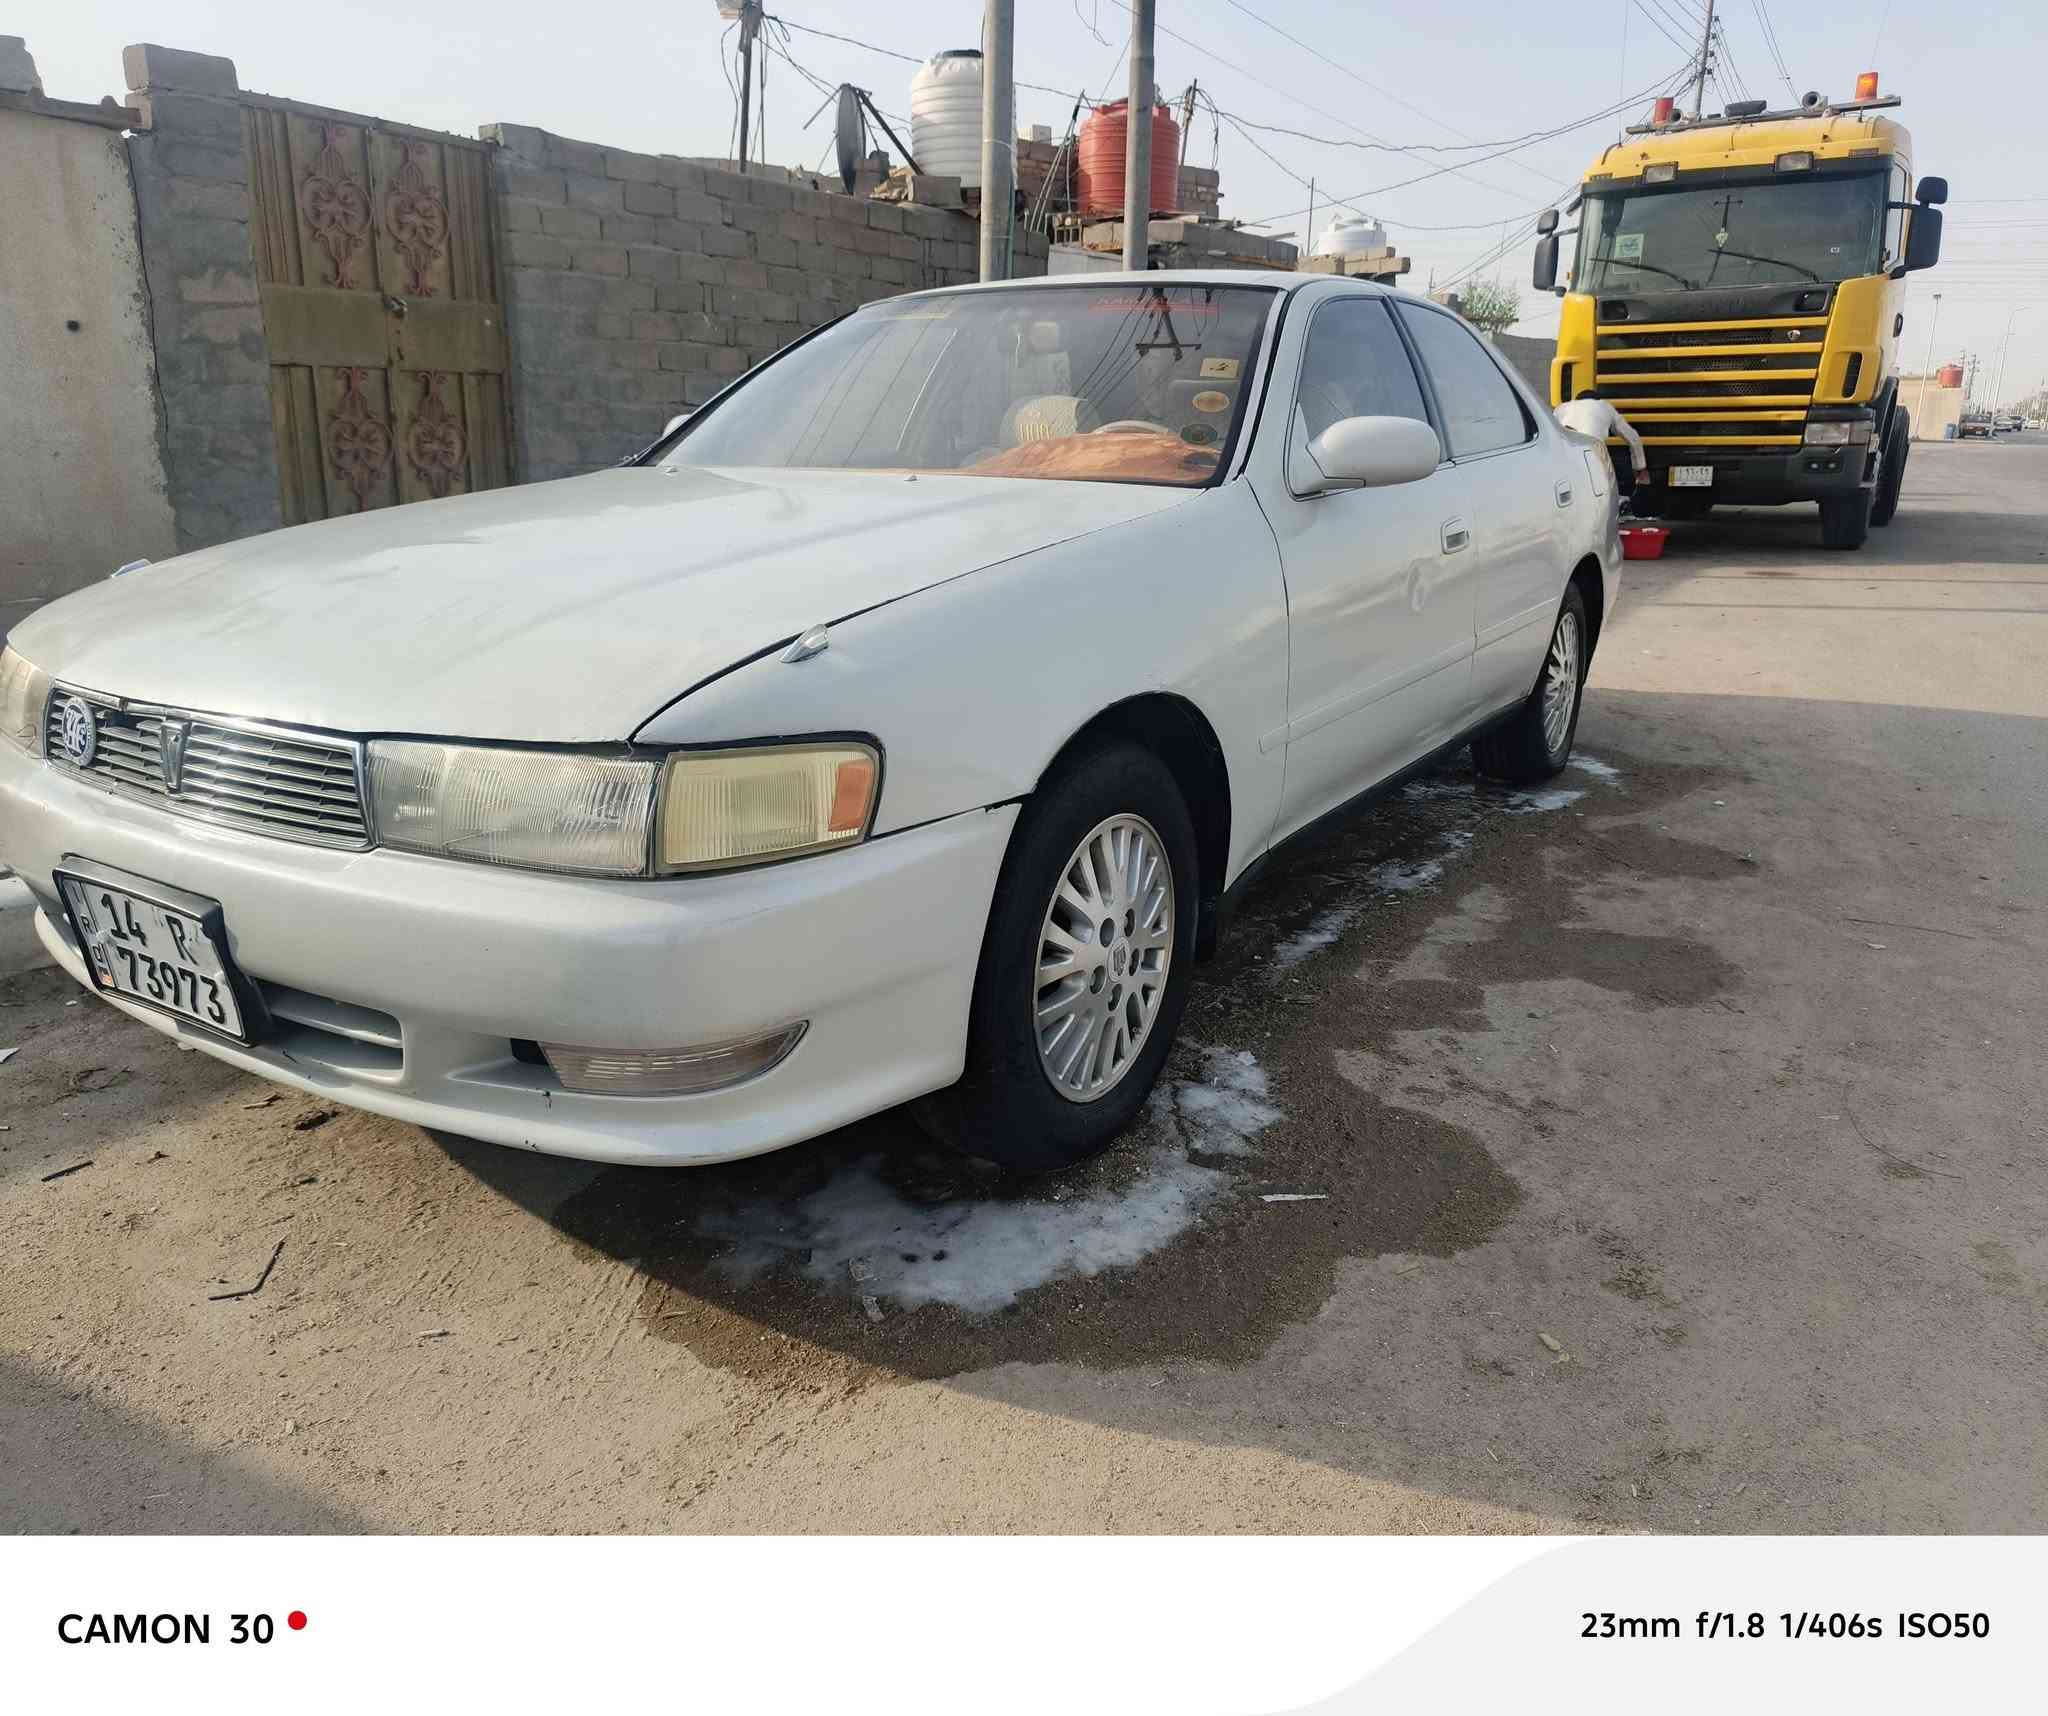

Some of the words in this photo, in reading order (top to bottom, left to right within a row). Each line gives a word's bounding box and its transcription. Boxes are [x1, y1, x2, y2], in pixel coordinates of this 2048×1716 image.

[101, 893, 147, 946] 14
[165, 914, 198, 965] R
[116, 945, 226, 1025] 73973
